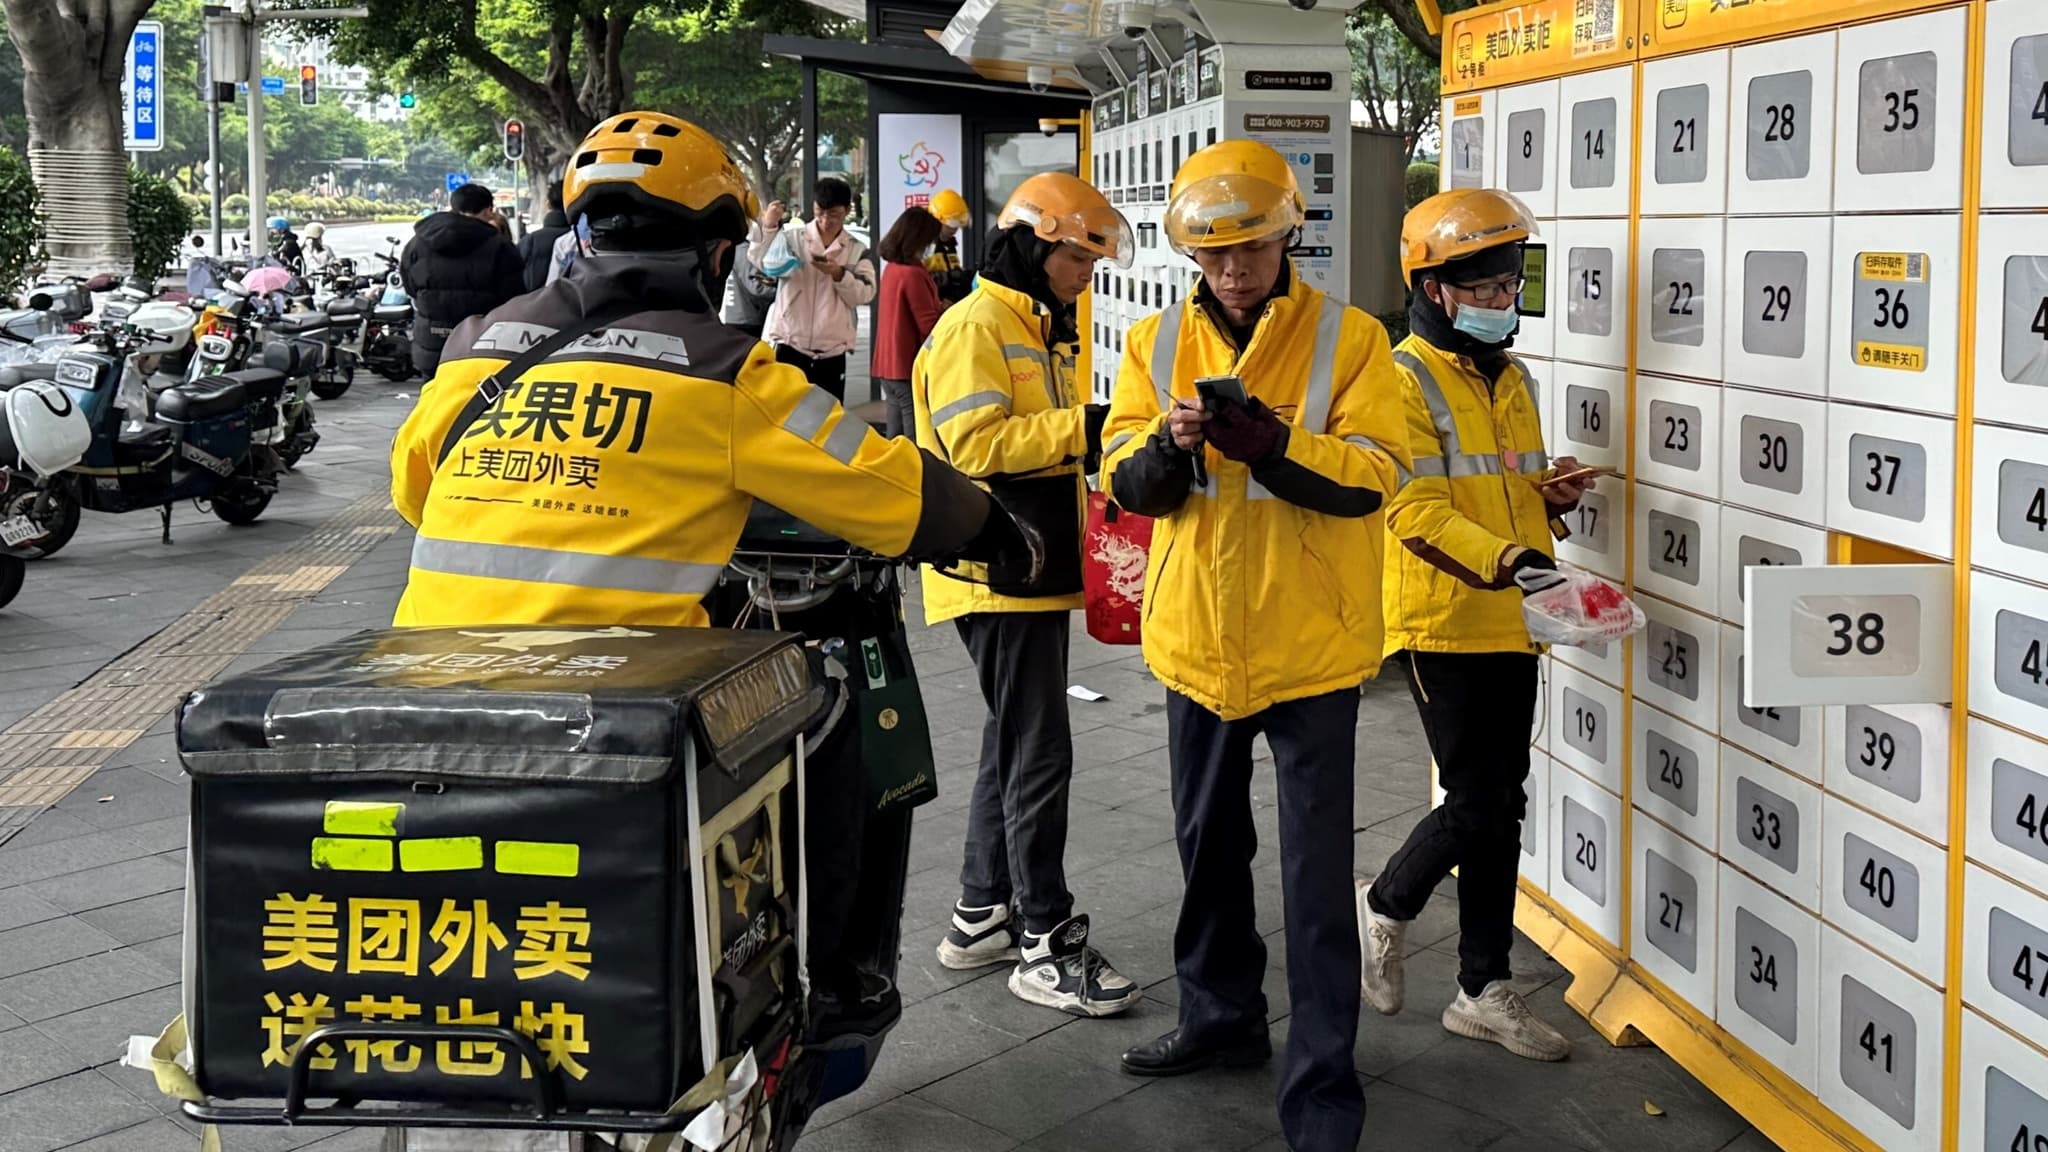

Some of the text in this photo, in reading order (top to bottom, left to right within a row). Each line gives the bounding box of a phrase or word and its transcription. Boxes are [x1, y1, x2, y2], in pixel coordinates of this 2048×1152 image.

[1486, 20, 1550, 61] 美团外卖柜
[1574, 22, 1593, 43] 存取
[136, 65, 153, 123] 等待区
[1883, 88, 1919, 133] 35
[1266, 118, 1325, 128] 400-903-9757
[1673, 118, 1695, 153] 21
[1764, 103, 1795, 142] 28
[1464, 143, 1469, 169] 1
[1523, 130, 1532, 159] 8
[1584, 129, 1604, 160] 14
[1584, 269, 1601, 300] 15
[1668, 281, 1693, 316] 22
[1762, 285, 1791, 322] 29
[1873, 287, 1909, 329] 36
[1872, 350, 1919, 367] 请随手关门
[1581, 399, 1601, 433] 16
[1664, 416, 1689, 452] 23
[453, 446, 600, 489] 上美团外卖
[1758, 433, 1788, 473] 30
[1865, 452, 1901, 495] 37
[531, 498, 576, 512] 美团外卖
[1577, 503, 1598, 538] 17
[1663, 529, 1688, 567] 24
[1826, 612, 1885, 656] 38
[1662, 641, 1687, 680] 25
[2021, 639, 2048, 691] 4
[1575, 707, 1596, 742] 19
[1860, 726, 1895, 772] 39
[1659, 749, 1683, 790] 26
[877, 771, 928, 809] Avocado
[1751, 804, 1781, 850] 33
[1575, 832, 1597, 872] 20
[1860, 858, 1895, 908] 40
[1659, 892, 1683, 933] 27
[262, 892, 592, 982] 美团外卖
[1750, 945, 1778, 992] 34
[261, 991, 590, 1081] 送花也快
[1859, 1021, 1893, 1074] 41
